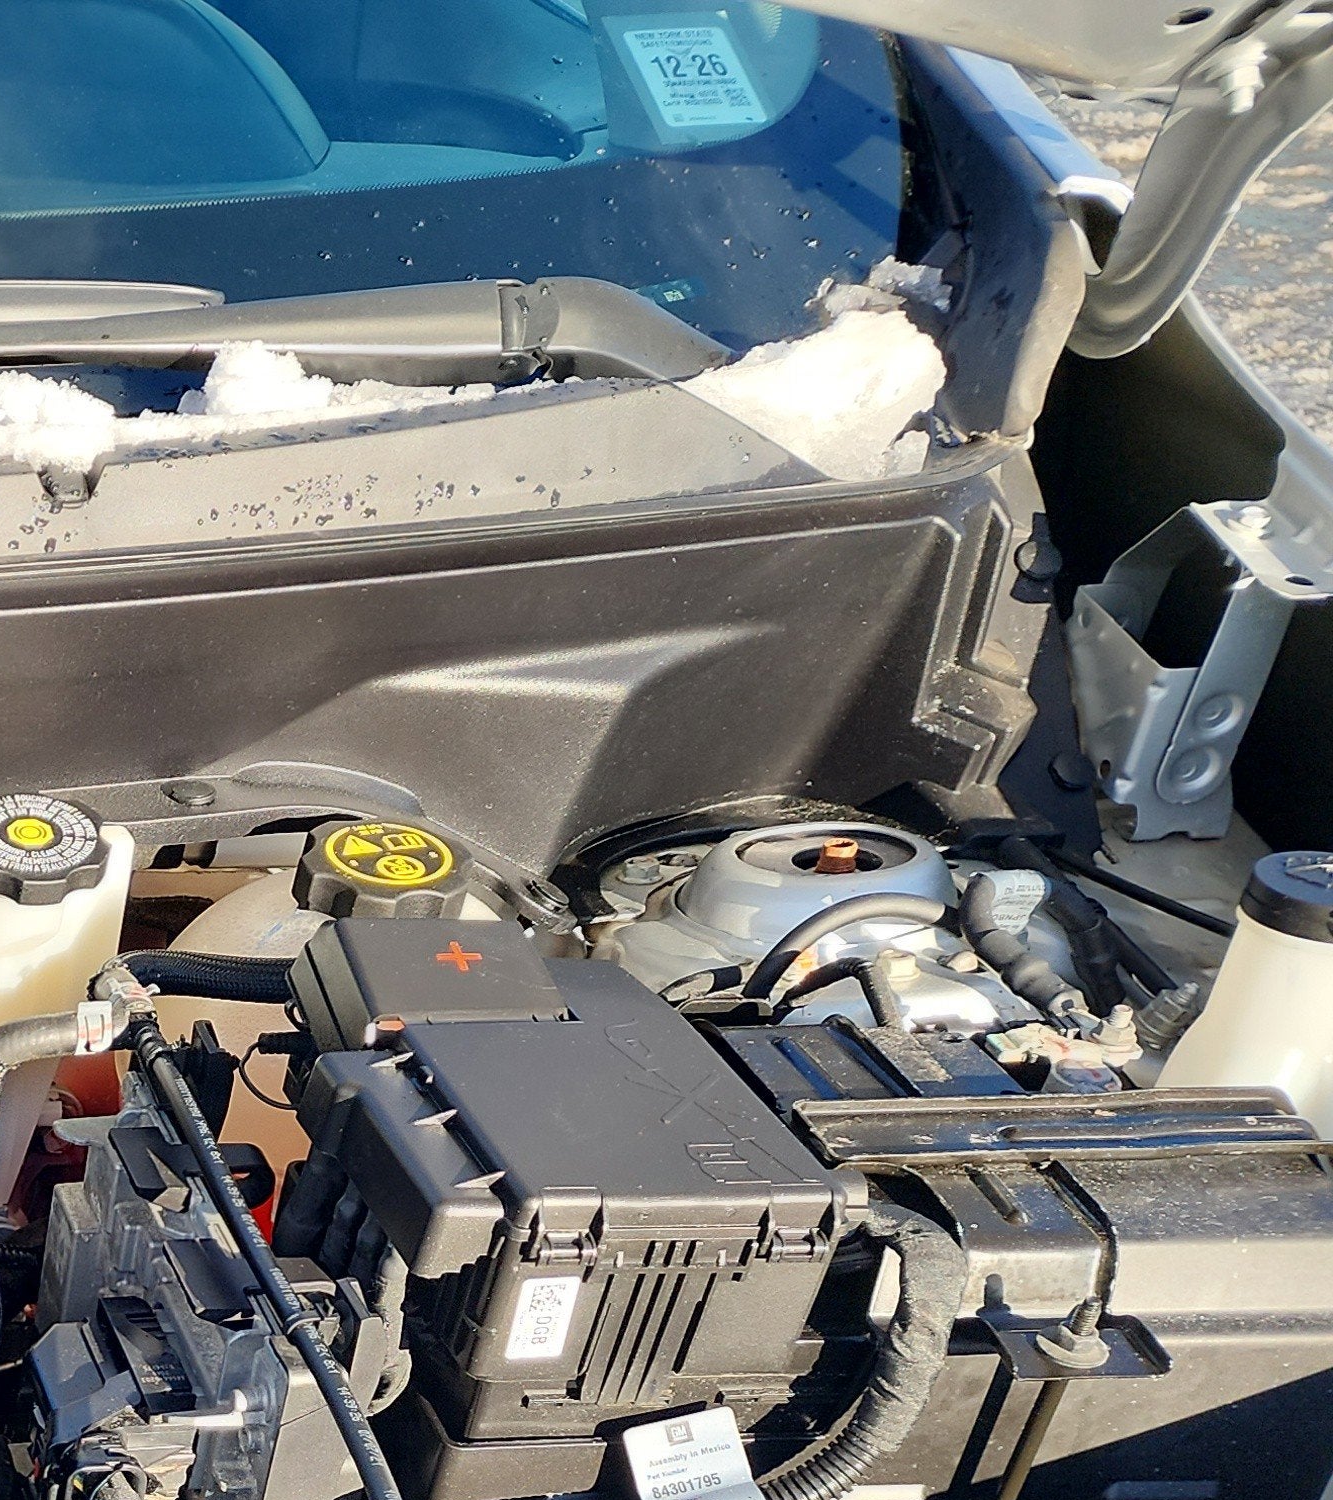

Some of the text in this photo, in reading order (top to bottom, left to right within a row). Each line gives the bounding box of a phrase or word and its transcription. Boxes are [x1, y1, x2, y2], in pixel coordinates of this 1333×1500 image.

[650, 53, 728, 78] 12-26
[649, 1453, 689, 1468] Assembly
[700, 1444, 731, 1456] Mexico
[651, 1472, 722, 1500] 84301795
